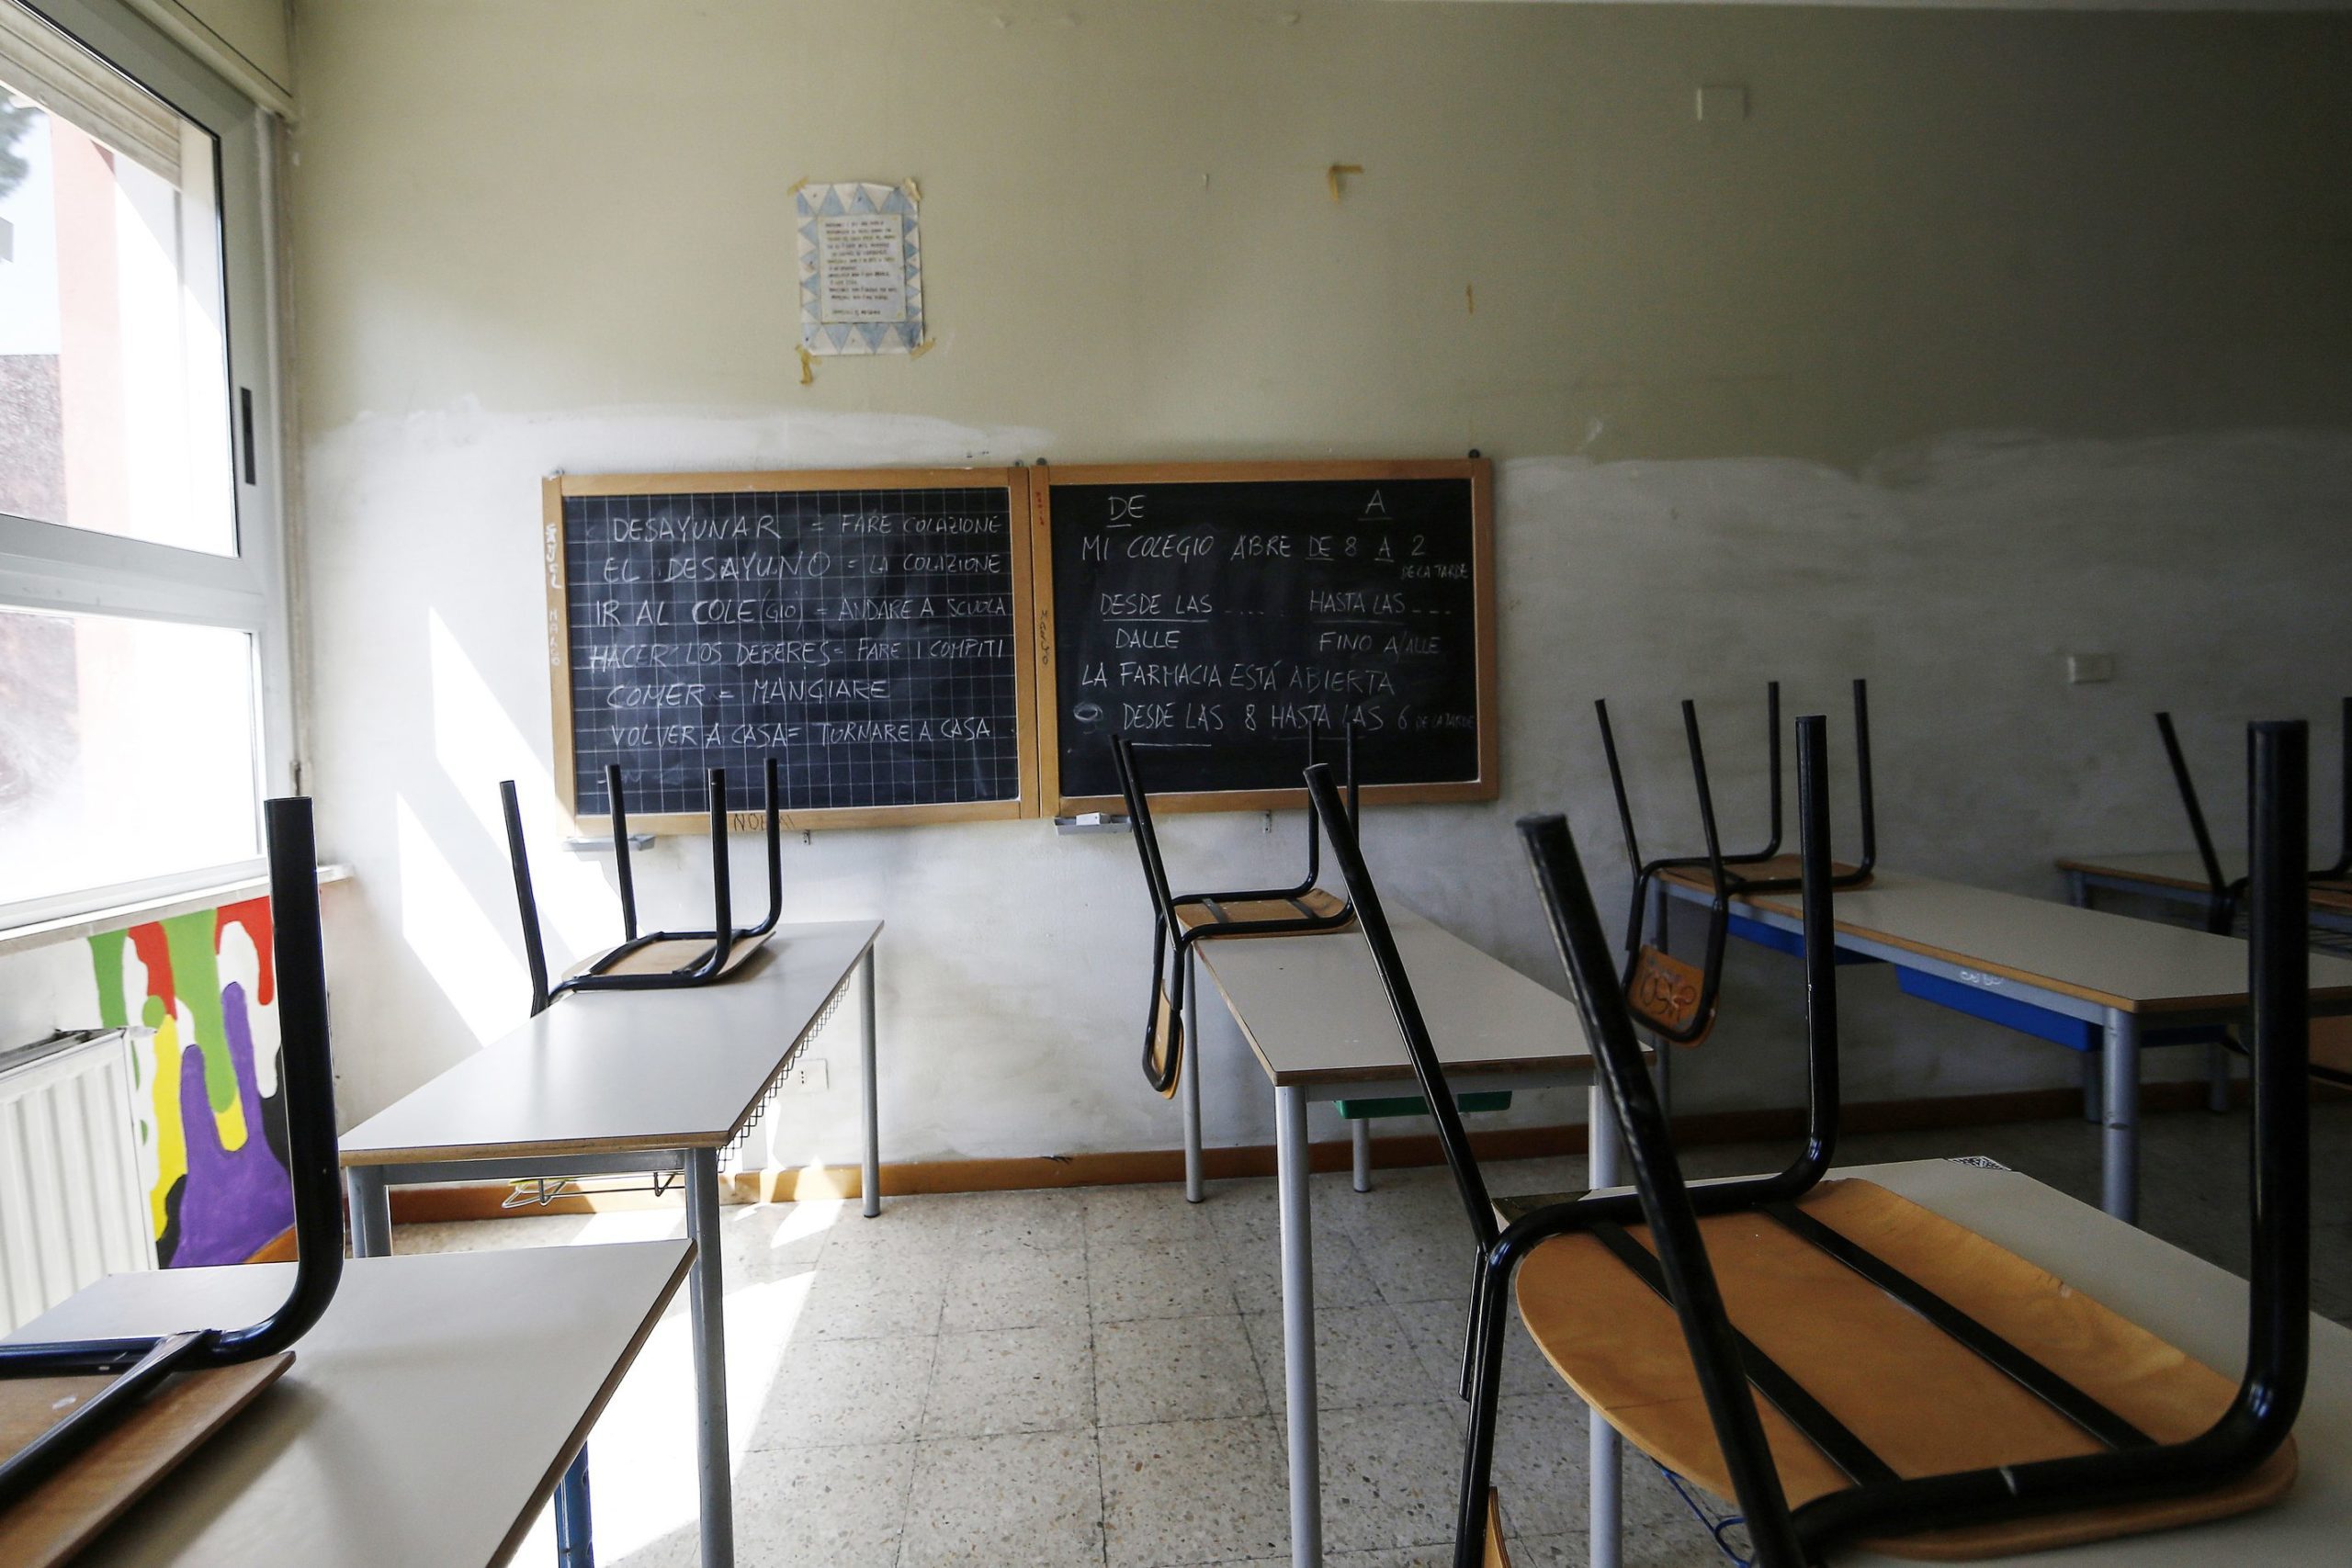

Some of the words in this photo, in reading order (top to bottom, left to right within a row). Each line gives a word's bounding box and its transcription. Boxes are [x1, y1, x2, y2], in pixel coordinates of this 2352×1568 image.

[1108, 495, 1147, 521] DE
[1365, 490, 1385, 514] A
[614, 514, 782, 543] DESAYUNAR
[842, 513, 891, 533] FARE
[903, 515, 1002, 534] COLAZIONE
[1082, 536, 1110, 561] MI
[1126, 535, 1214, 563] COLEGIO
[1230, 536, 1291, 561] ABRE
[1309, 536, 1331, 557] DE
[1344, 536, 1357, 557] 8
[1379, 536, 1391, 558] A
[1411, 535, 1425, 556] 2
[604, 557, 640, 582] EL
[664, 551, 831, 582] DESAYUNO
[869, 555, 888, 573] LA
[903, 553, 1001, 573] COLAZIONE
[596, 600, 621, 626] IR
[636, 600, 670, 626] AL
[839, 598, 913, 621] ANDARE
[921, 597, 934, 617] A
[947, 598, 1006, 617] SCUOLA
[1101, 594, 1161, 615] DESDE
[1176, 594, 1213, 614] LAS
[1309, 591, 1365, 613] HASTA
[1374, 593, 1406, 614] LAS
[1115, 628, 1181, 649] DALLE
[1319, 632, 1373, 651] FINO
[590, 644, 668, 672] HACER
[686, 642, 722, 665] LOS
[858, 637, 901, 661] FARE
[931, 638, 1003, 659] COMPITI
[607, 683, 706, 707] COMER
[753, 677, 889, 705] MANGIARE
[1082, 662, 1108, 687] LA
[1120, 662, 1222, 687] FARMACIA
[1230, 660, 1282, 690] ESTÁ
[1289, 665, 1395, 695] ABIERTA
[1123, 702, 1175, 730] DESDE
[1186, 703, 1224, 731] LAS
[1245, 704, 1256, 731] 8
[1272, 703, 1330, 729] HASTA
[1397, 705, 1411, 729] 6
[611, 726, 698, 748] VOLVER
[706, 723, 722, 749] A
[920, 721, 933, 741] A
[941, 717, 990, 741] CASA
